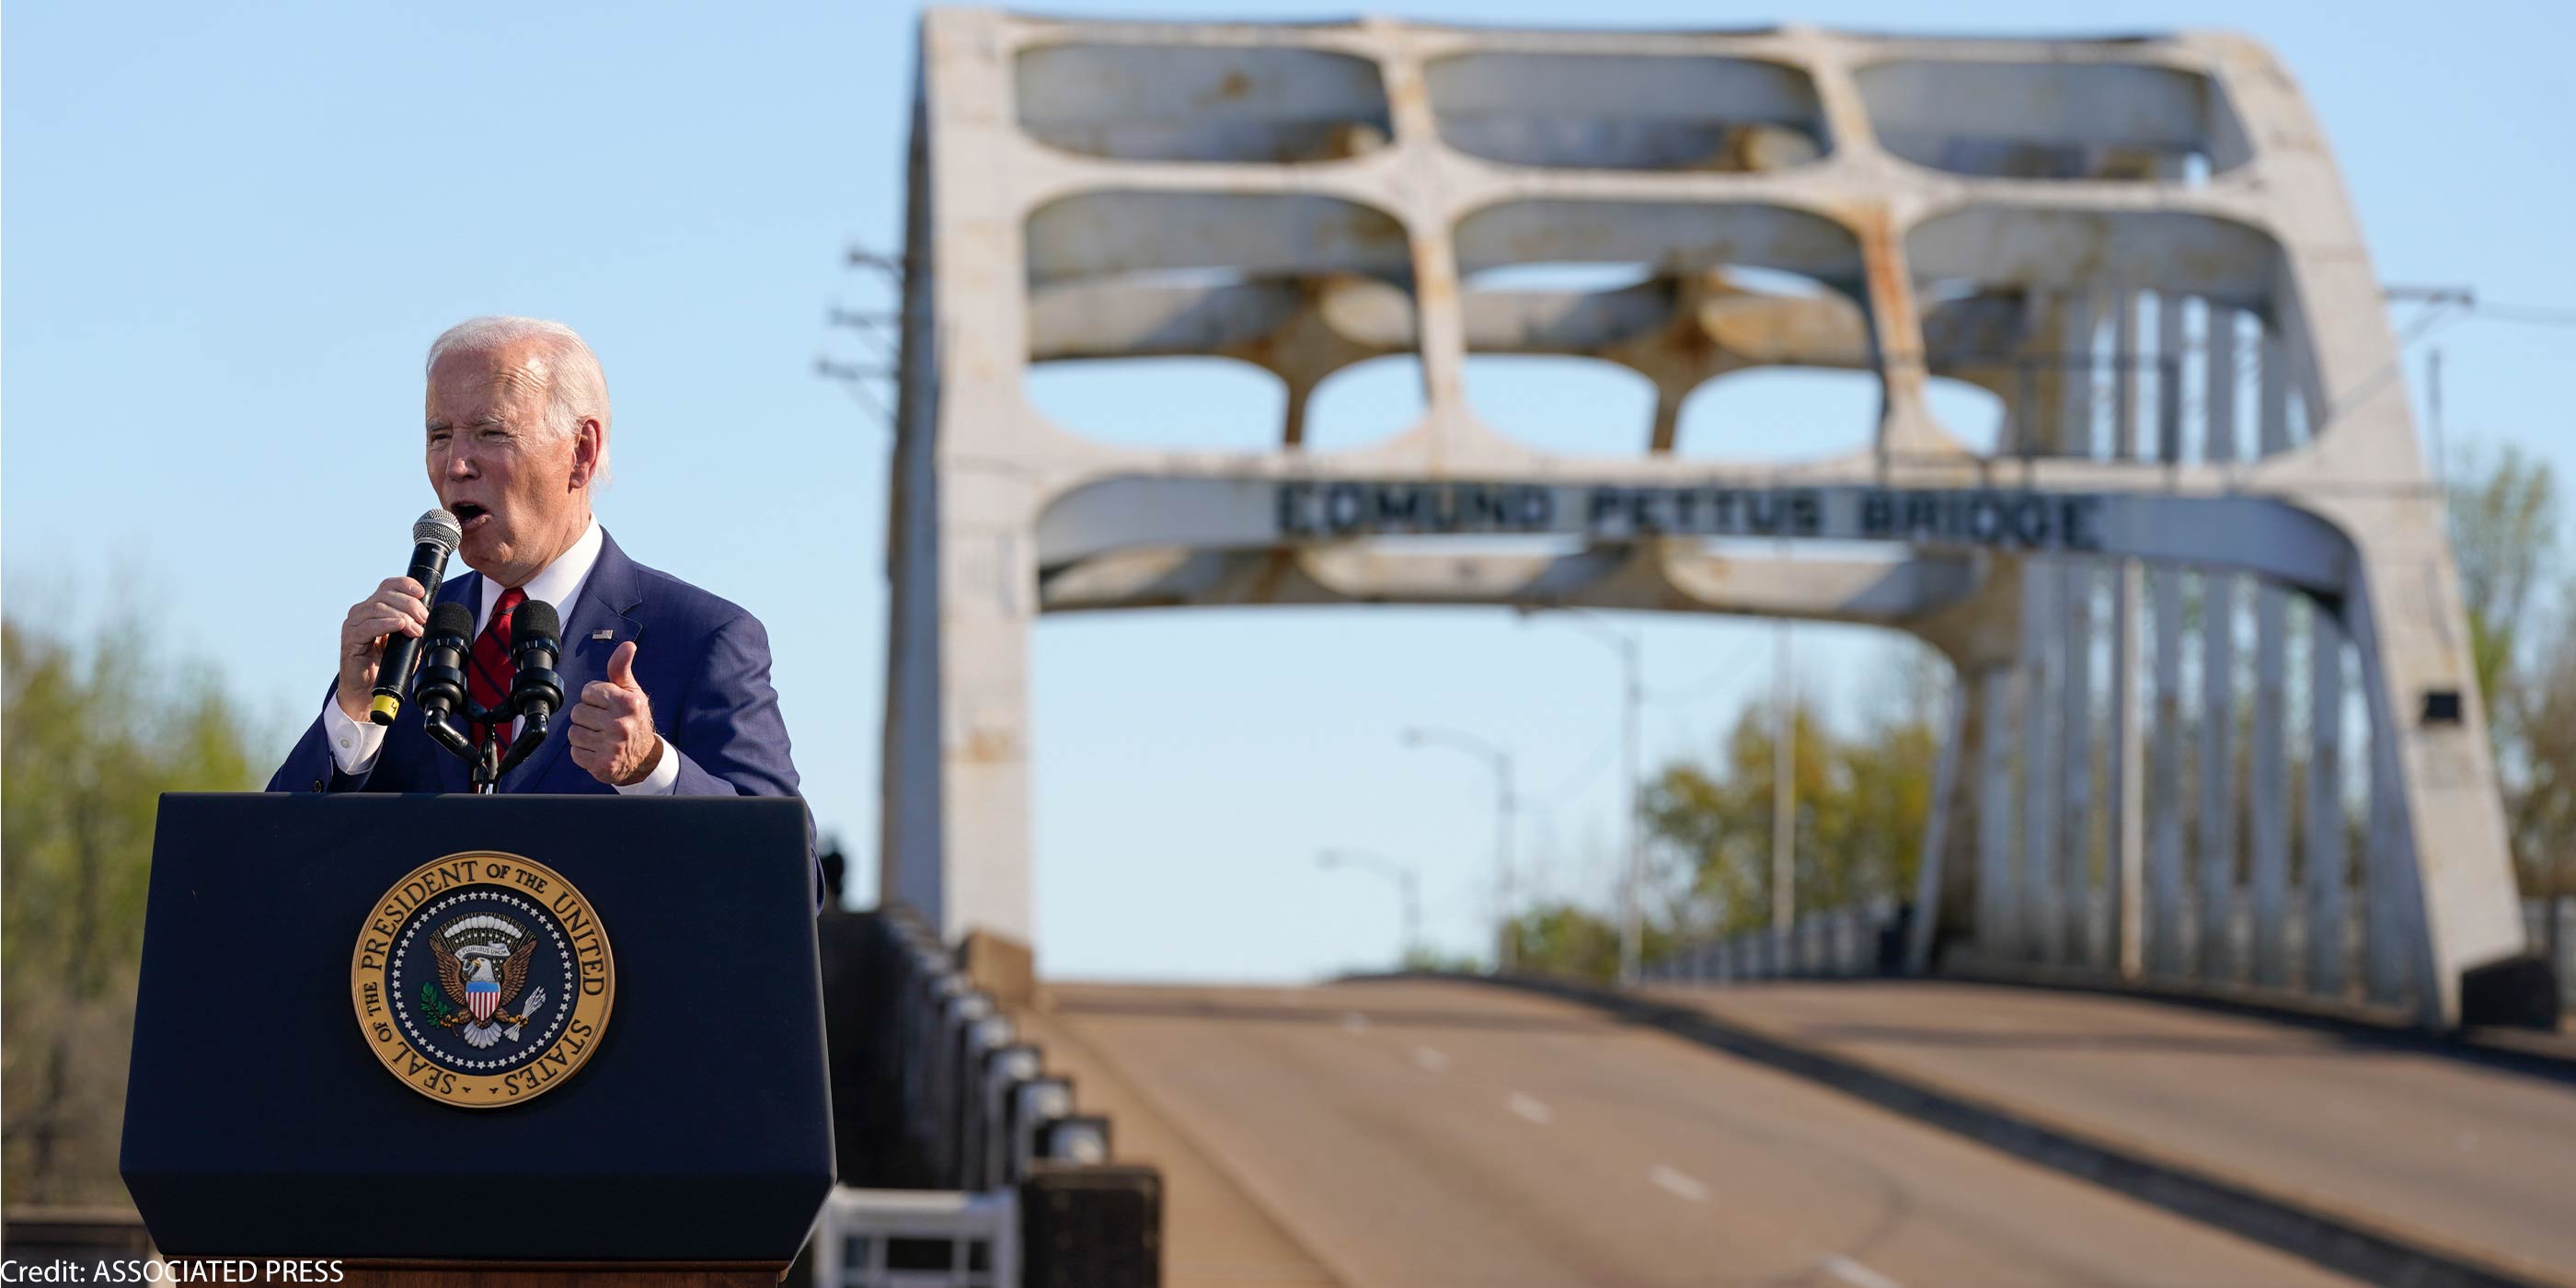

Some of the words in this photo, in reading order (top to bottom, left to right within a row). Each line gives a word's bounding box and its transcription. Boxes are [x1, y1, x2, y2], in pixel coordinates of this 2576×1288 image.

[1277, 481, 1555, 536] EDMUND
[1589, 485, 1823, 539] PETTUS
[1860, 489, 2102, 551] BRIDGE
[486, 863, 511, 879] OF
[515, 868, 548, 894] THE
[361, 860, 478, 972] PRESIDENT
[552, 891, 604, 996] UNITED
[363, 981, 383, 1017] THE
[373, 1020, 393, 1043] OF
[503, 1018, 592, 1096] STATES
[392, 1041, 457, 1095] SEAL
